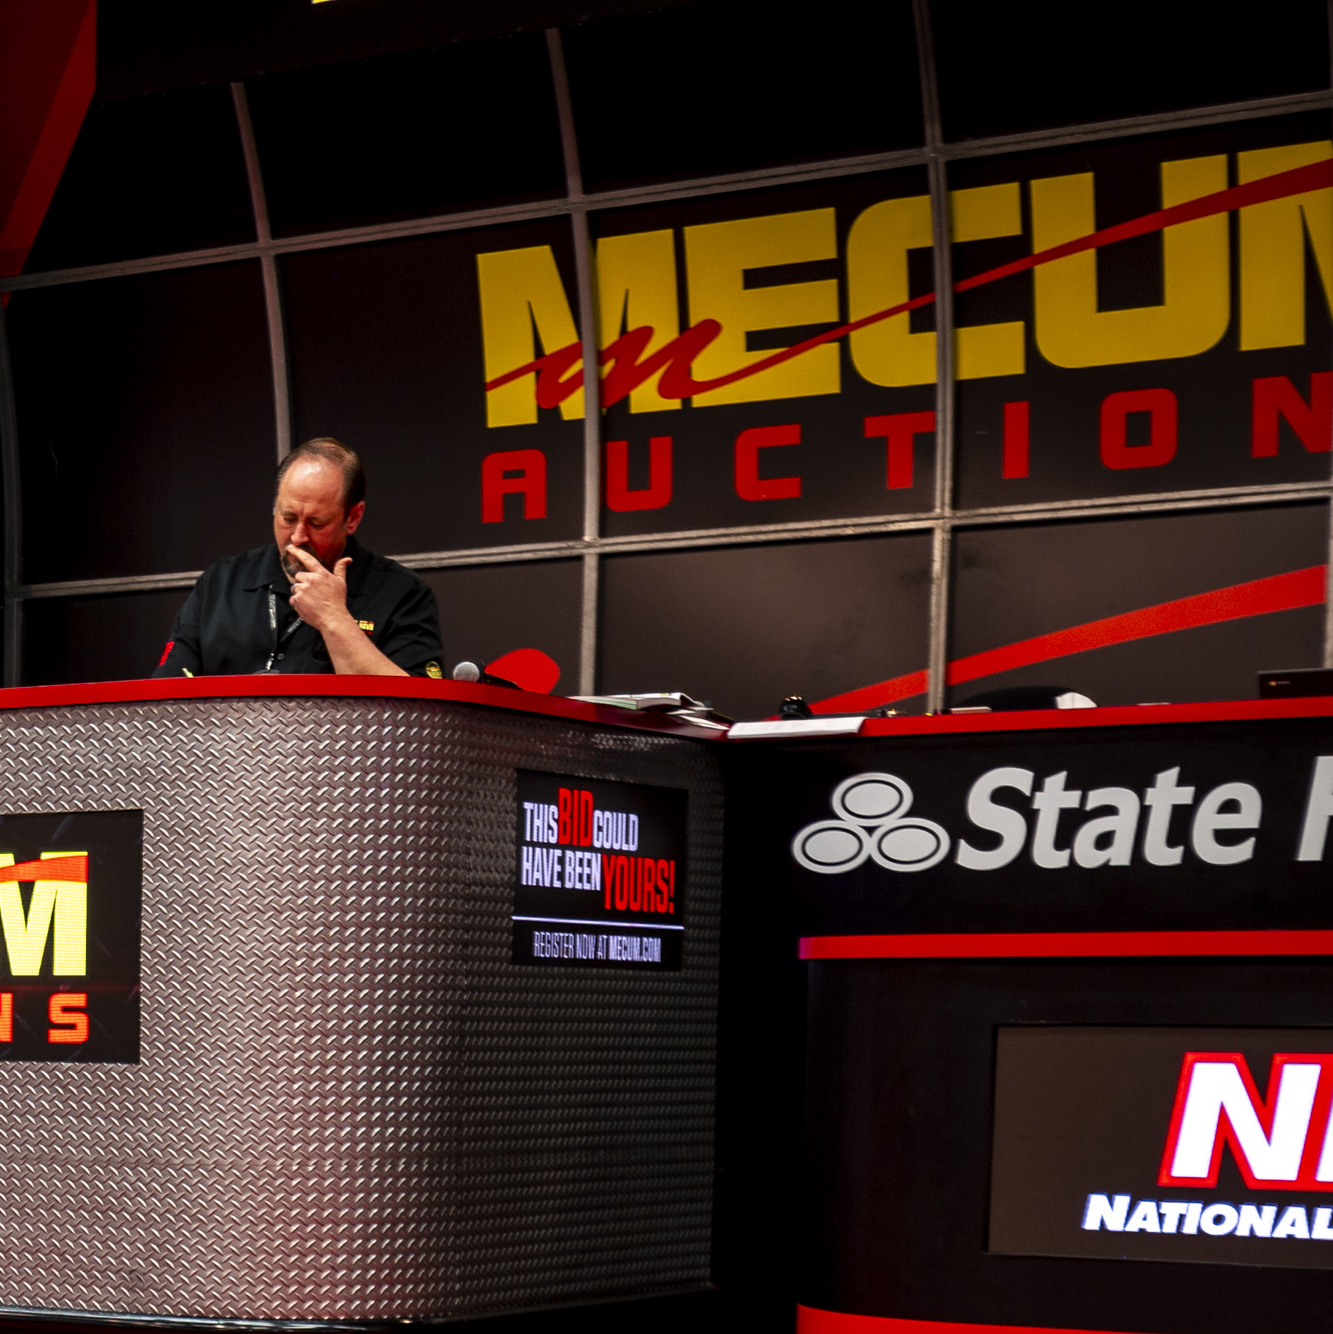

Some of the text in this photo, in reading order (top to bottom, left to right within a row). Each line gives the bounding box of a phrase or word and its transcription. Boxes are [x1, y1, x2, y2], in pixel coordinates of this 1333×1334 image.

[522, 787, 639, 851] THIS BID COULD
[955, 766, 1262, 871] State
[521, 846, 676, 914] HAVE BEEN YOURS!
[533, 931, 662, 963] REGISTER NOW AT MECUM.COM
